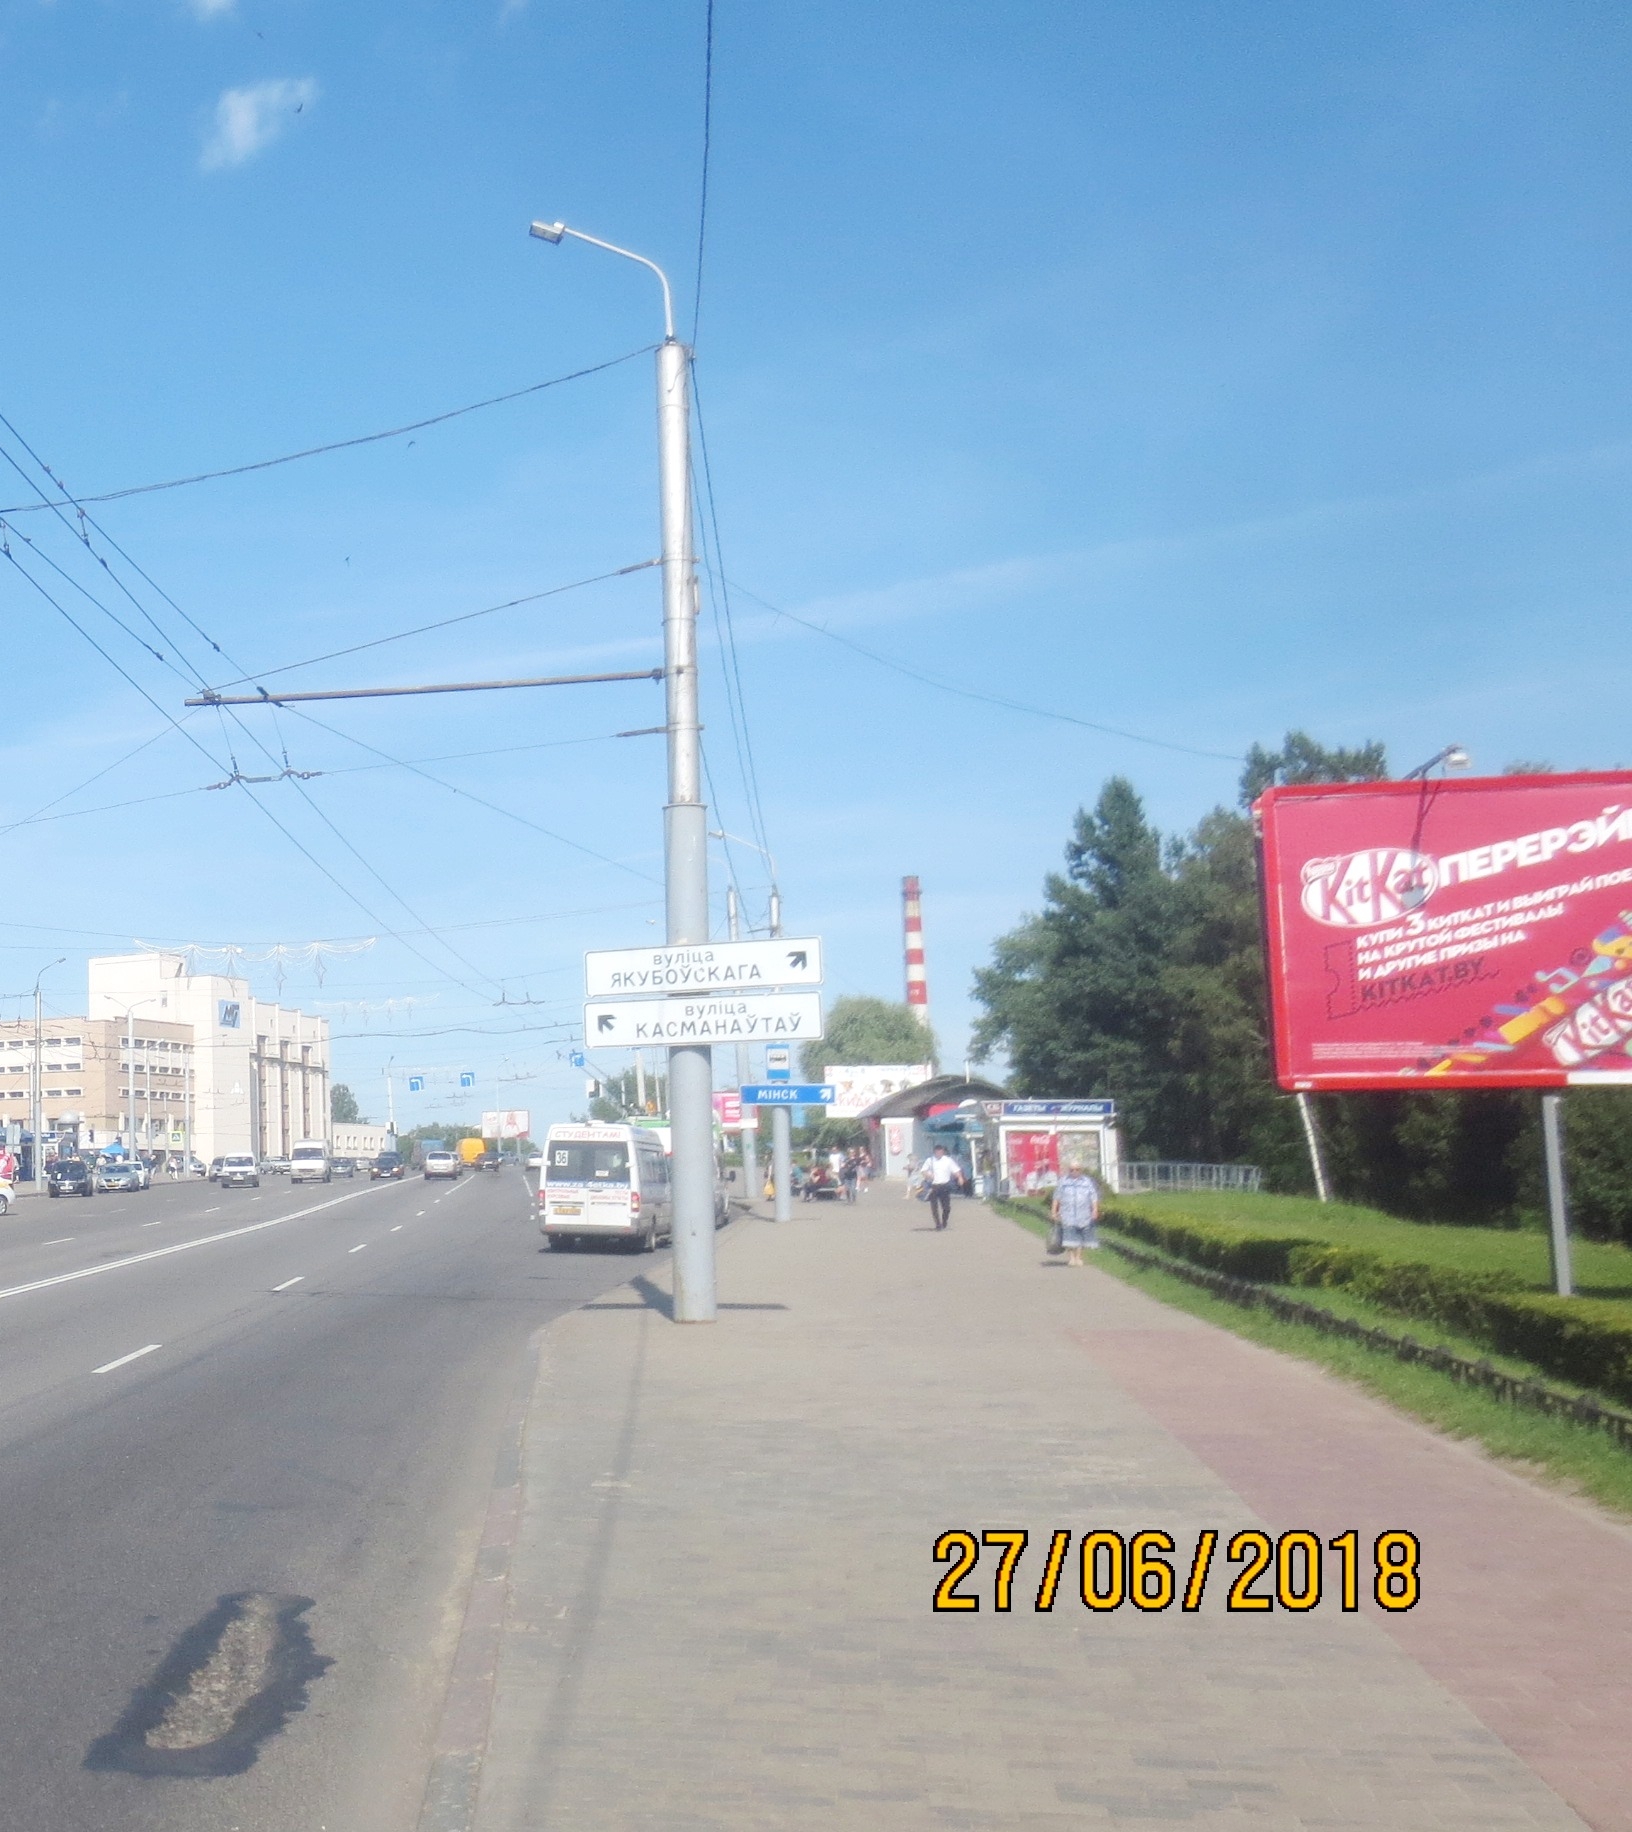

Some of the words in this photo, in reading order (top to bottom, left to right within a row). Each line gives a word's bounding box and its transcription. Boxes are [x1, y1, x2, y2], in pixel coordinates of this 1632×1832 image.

[1438, 804, 1632, 888] ПЕРЕРЭЙ
[1319, 850, 1430, 925] KitKat
[1356, 926, 1403, 949] КУПИ
[1406, 911, 1425, 935] 3
[1427, 903, 1495, 929] КИТКАТ
[1497, 900, 1510, 914] И
[1512, 876, 1593, 908] ВЫИГРАЙ
[653, 950, 714, 967] вуліца
[1357, 948, 1382, 965] НА
[1383, 927, 1452, 958] КРУТОЙ
[1358, 966, 1372, 981] И
[1373, 950, 1438, 979] ДРУГИЕ
[1439, 935, 1498, 962] ПРИЗЫ
[1501, 929, 1527, 946] НА
[610, 963, 762, 988] ЯКУБОЎСКАГА
[1361, 956, 1484, 1000] KITKAT.BY
[685, 1001, 748, 1018] вуліца
[636, 1012, 802, 1038] КАСМАНАЎТАЎ
[757, 1089, 798, 1100] МІНСК
[555, 1130, 621, 1139] СТУДЕНТАМ!
[556, 1151, 567, 1164] 36
